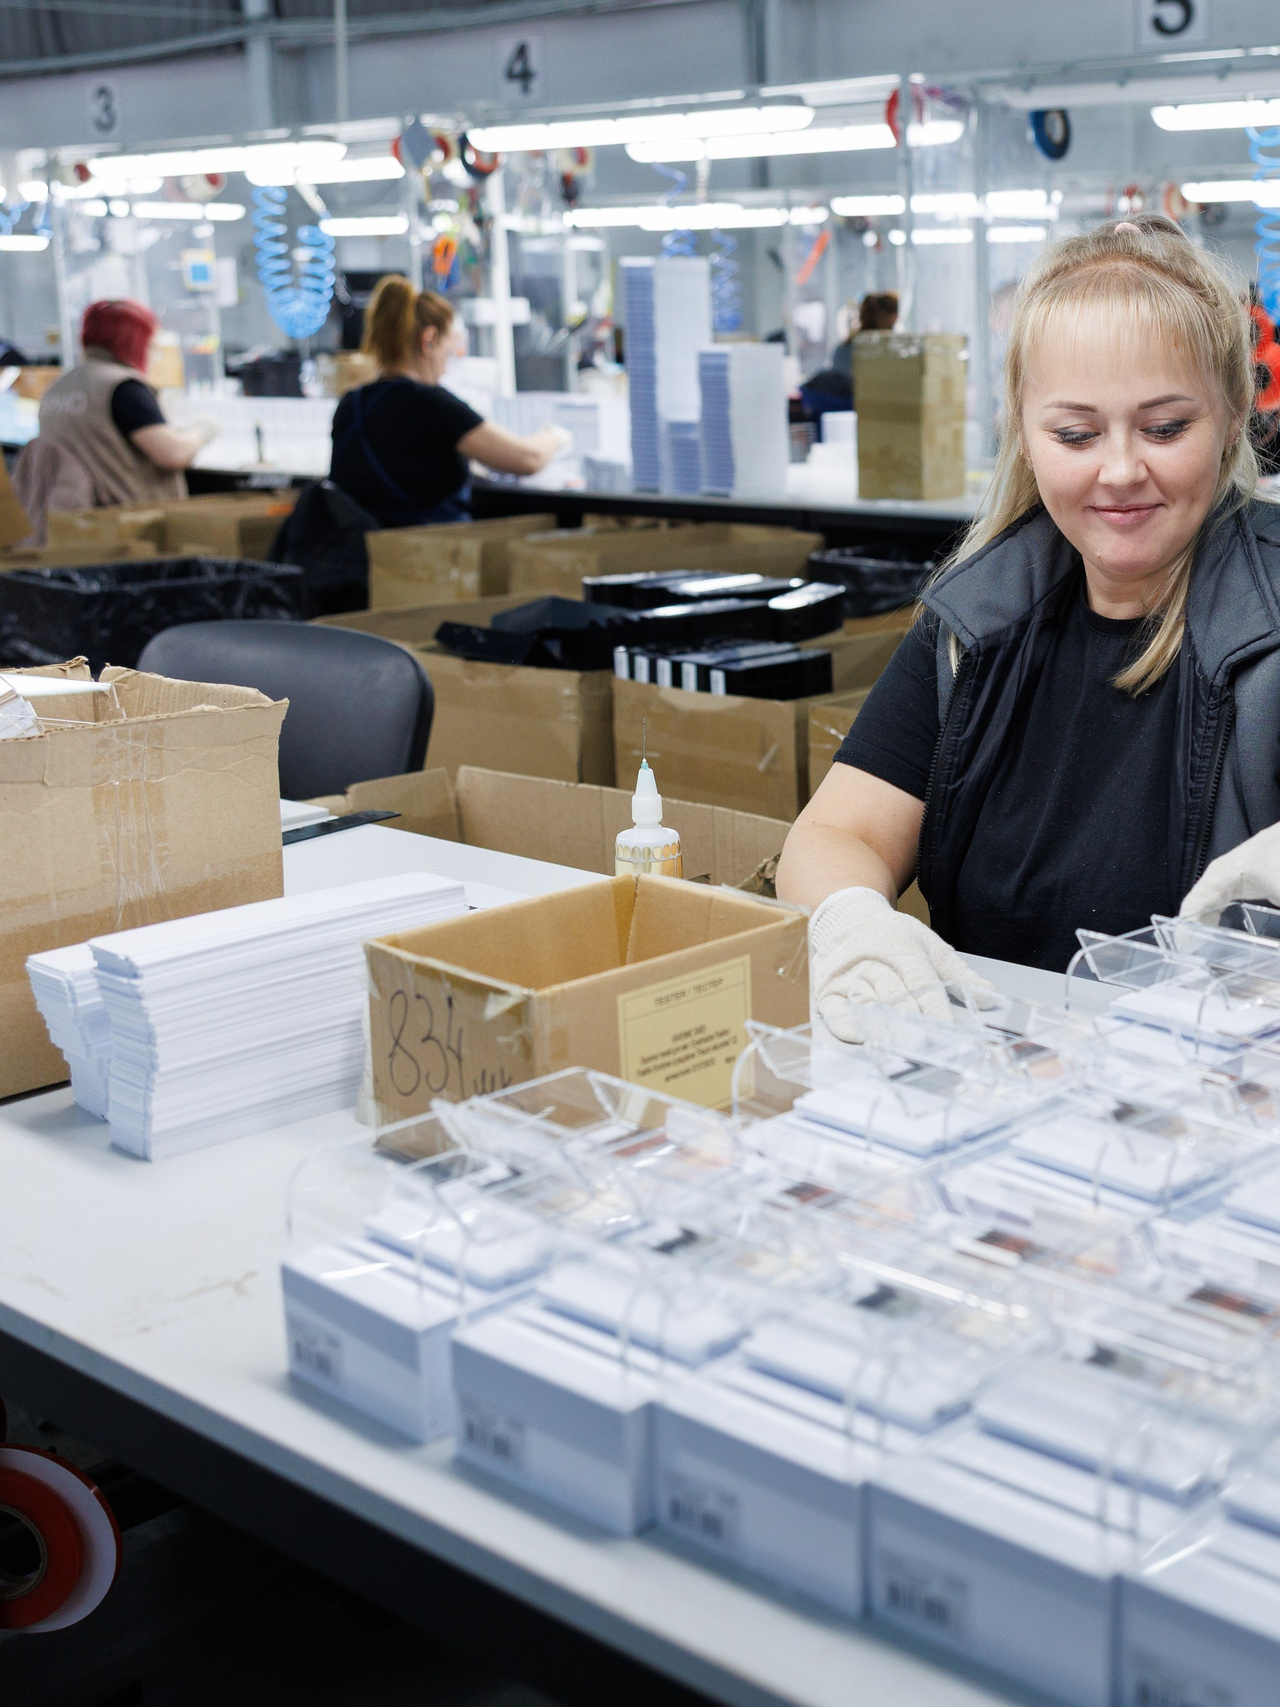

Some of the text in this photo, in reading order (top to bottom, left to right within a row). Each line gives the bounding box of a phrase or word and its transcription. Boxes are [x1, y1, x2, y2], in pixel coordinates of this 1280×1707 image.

[1152, 0, 1194, 36] 5
[504, 42, 536, 95] 4
[92, 86, 117, 132] 3
[655, 990, 687, 1007] TESTER
[388, 989, 466, 1101] 834
